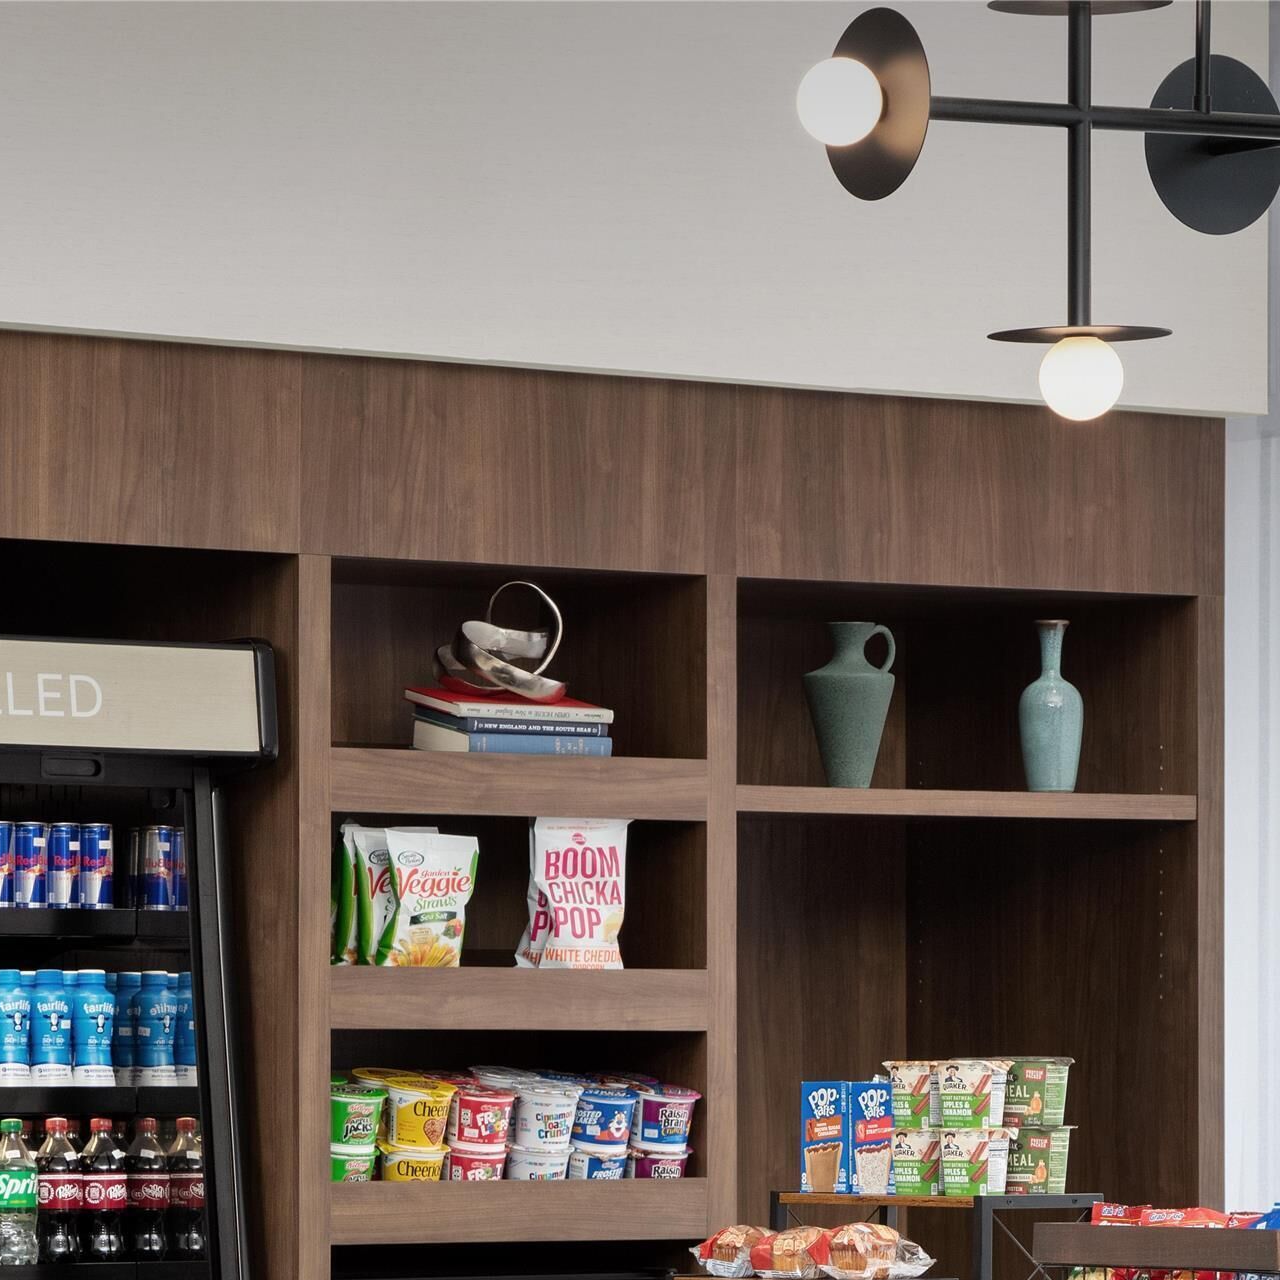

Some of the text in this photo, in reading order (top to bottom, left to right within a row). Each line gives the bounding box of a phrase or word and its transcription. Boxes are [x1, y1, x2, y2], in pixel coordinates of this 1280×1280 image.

[545, 846, 620, 880] BOOM
[420, 870, 450, 878] Garden
[397, 867, 471, 900] Veggie
[548, 880, 622, 905] CHICKA
[414, 897, 457, 912] Straws
[554, 907, 601, 939] POP
[545, 947, 580, 962] WHITE
[36, 1000, 69, 1014] fairlife
[660, 1108, 688, 1120] Raisin
[662, 1118, 686, 1129] Bran
[344, 1122, 373, 1141] JACKS
[538, 1128, 570, 1139] Crunch
[653, 1165, 680, 1177] Raisin
[801, 1173, 806, 1184] 8
[853, 1174, 858, 1185] 8
[1149, 1213, 1165, 1221] Grab
